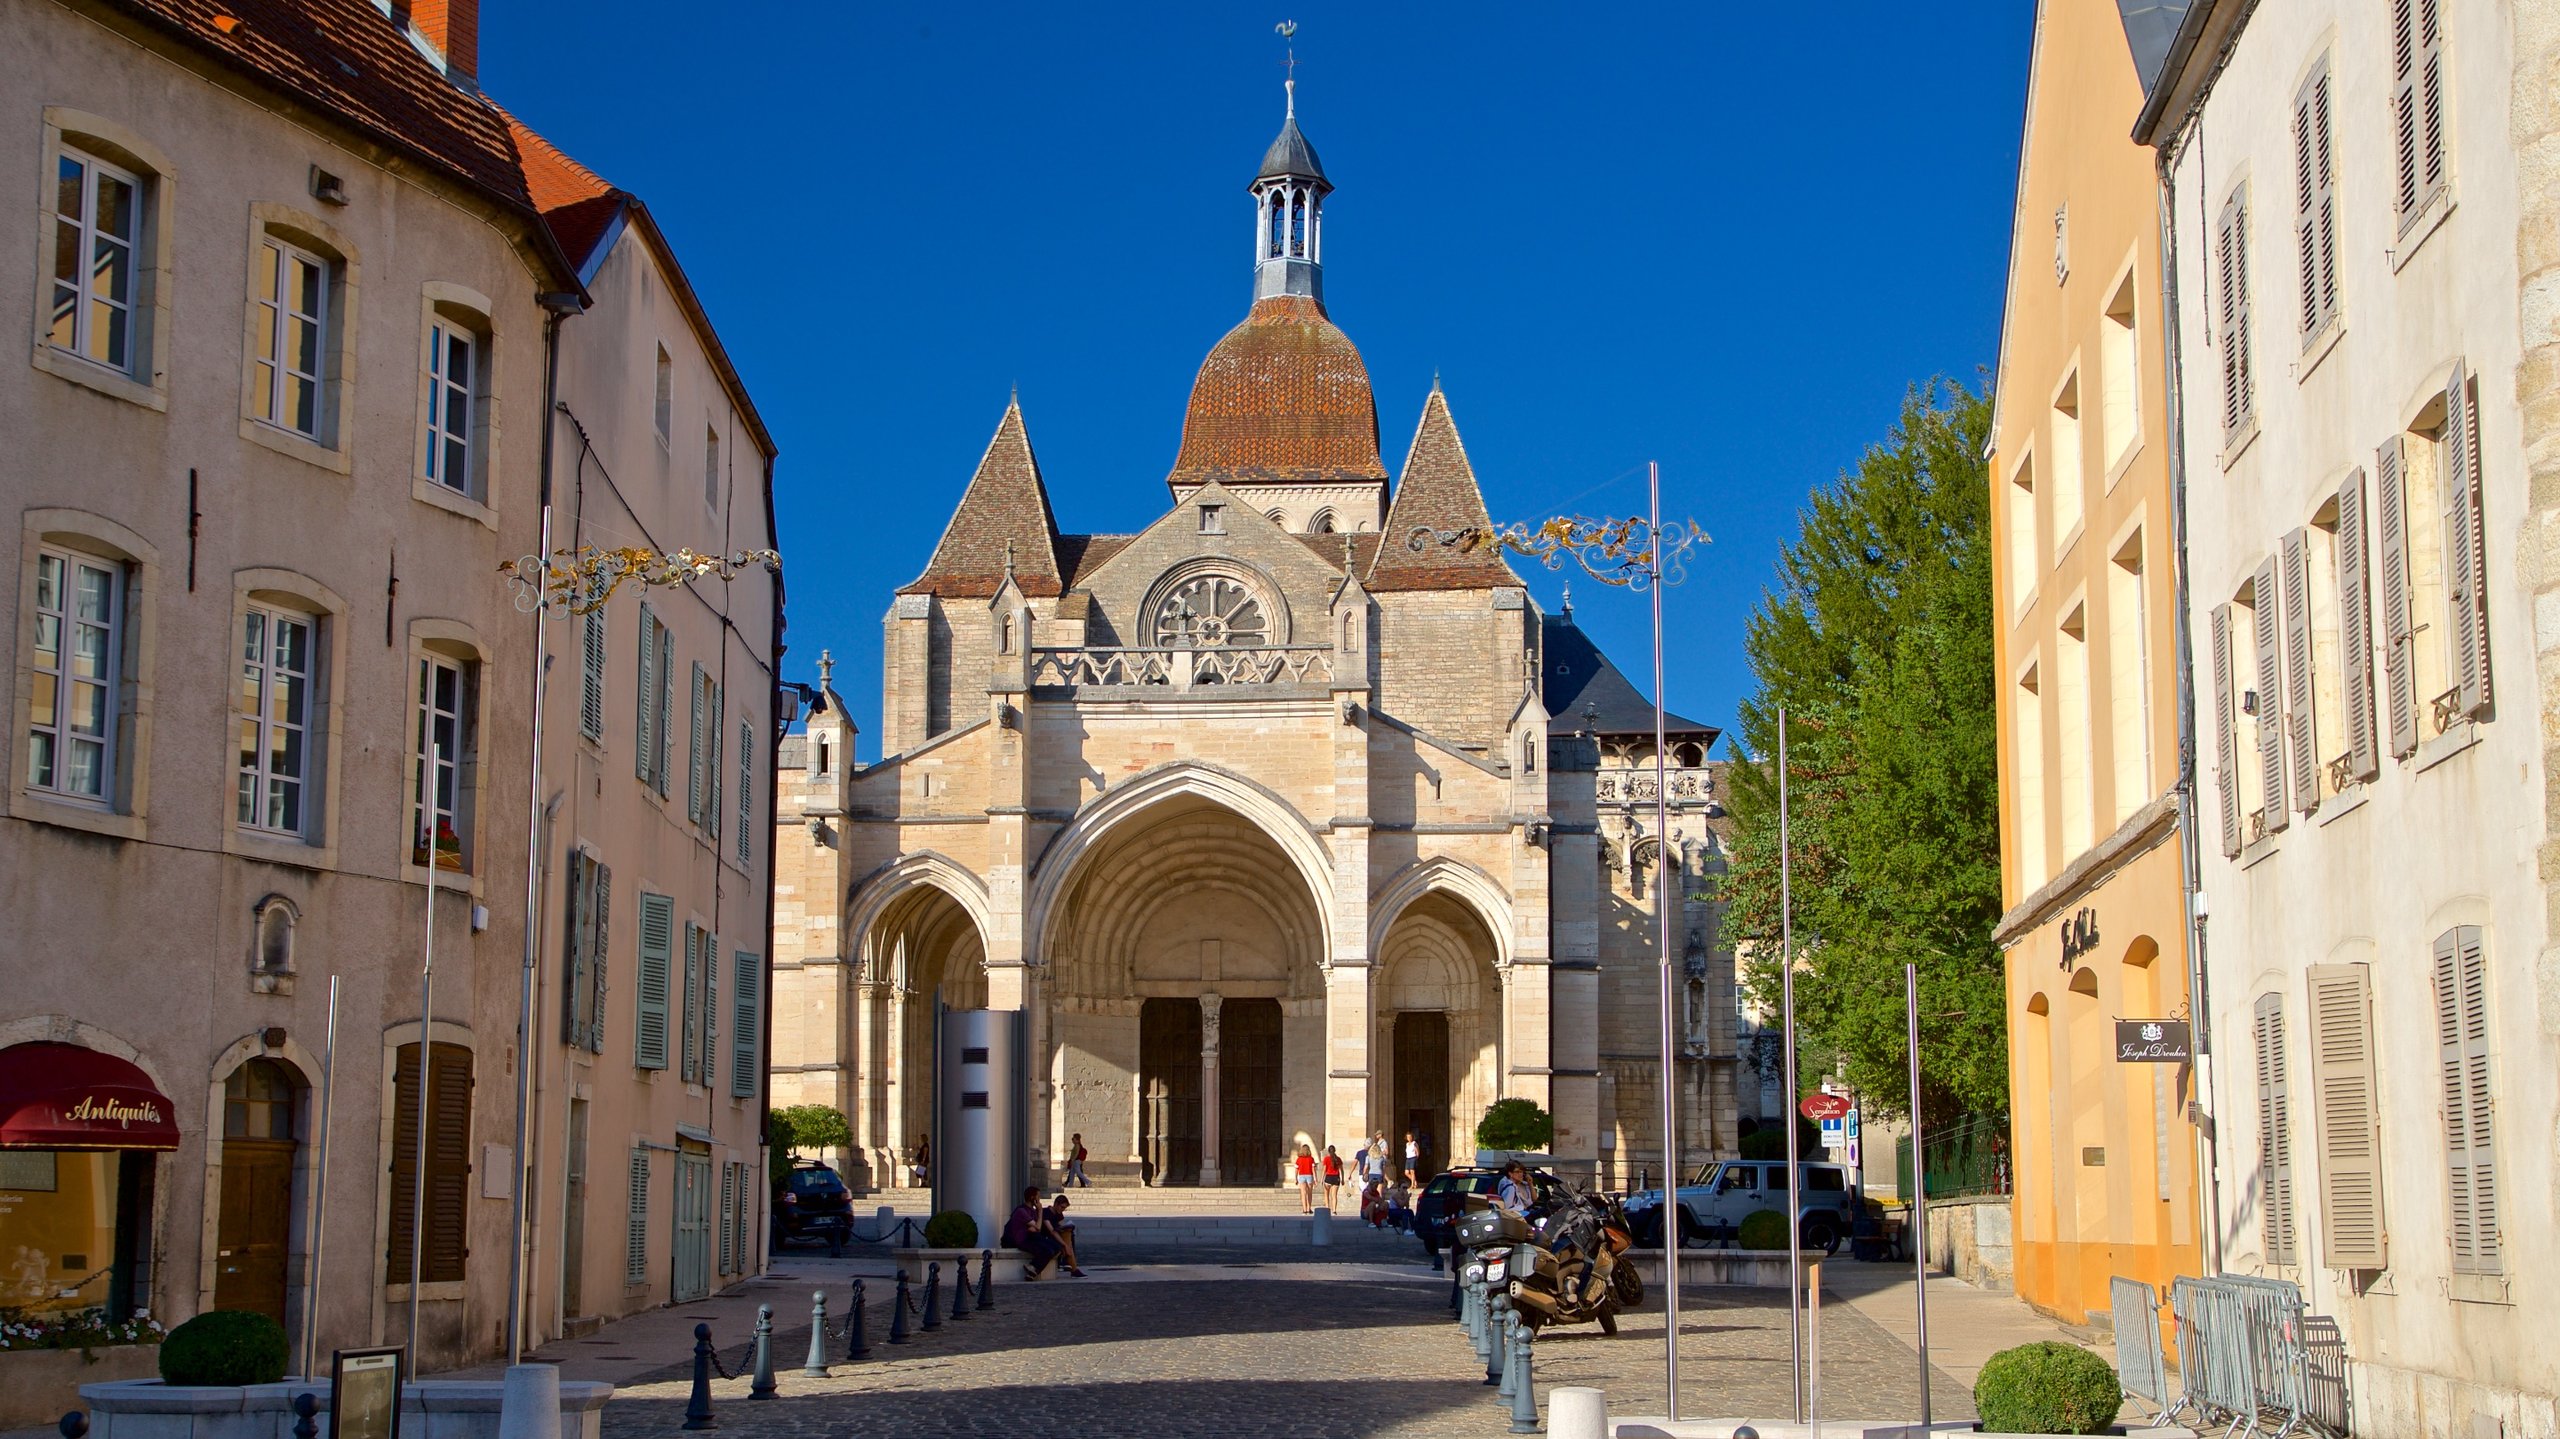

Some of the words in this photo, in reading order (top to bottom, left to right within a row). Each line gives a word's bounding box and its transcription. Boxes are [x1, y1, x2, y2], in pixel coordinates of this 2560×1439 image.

[2118, 1043, 2149, 1060] Joseph
[2150, 1043, 2186, 1057] Drouhin
[65, 1096, 160, 1130] Antiquités
